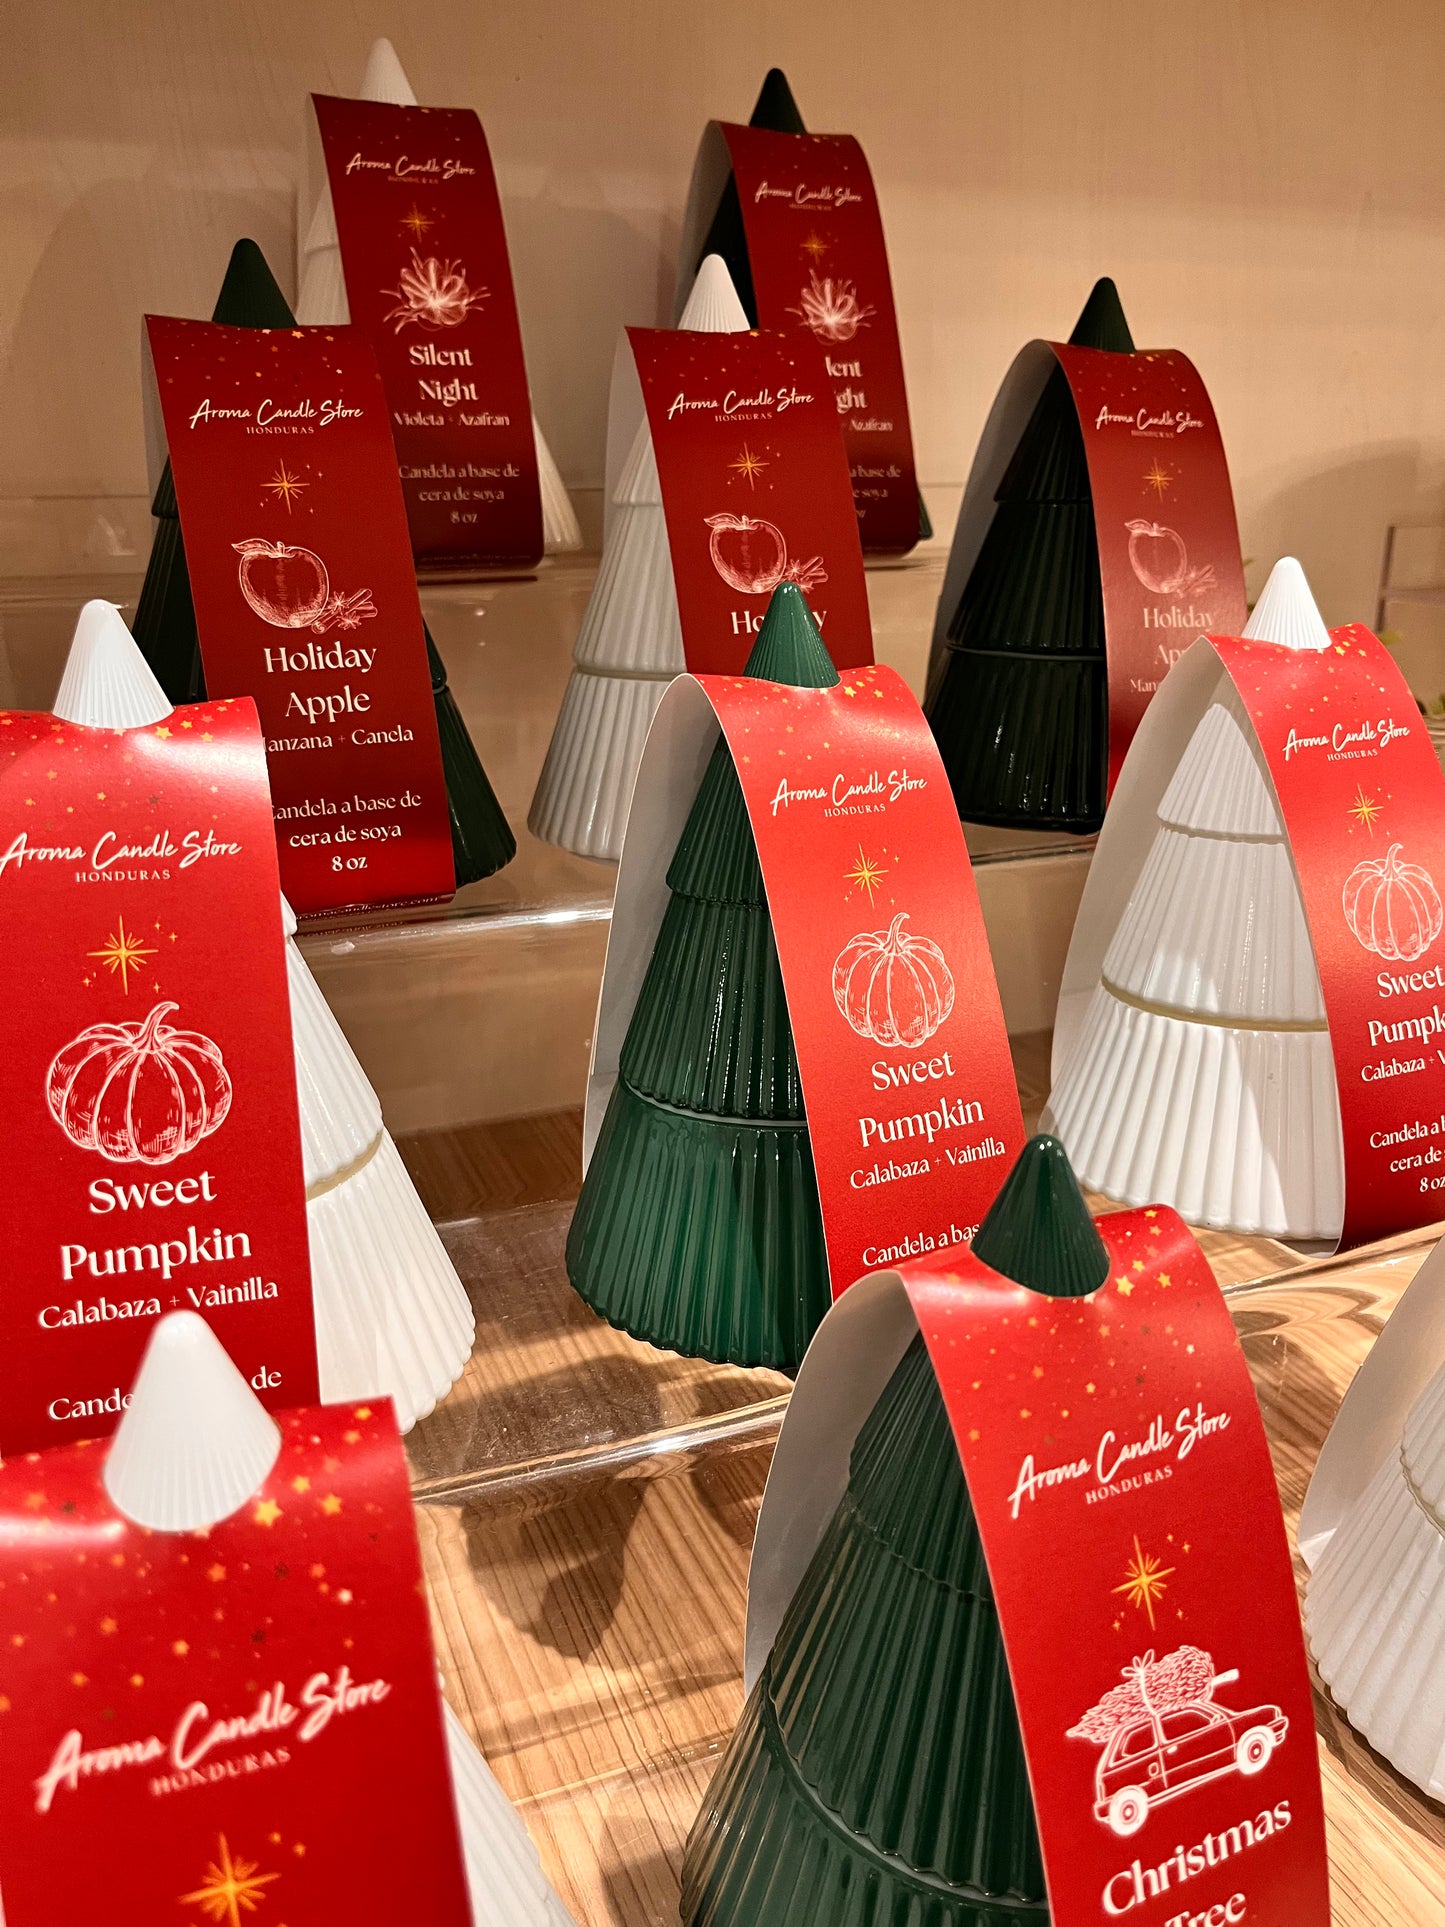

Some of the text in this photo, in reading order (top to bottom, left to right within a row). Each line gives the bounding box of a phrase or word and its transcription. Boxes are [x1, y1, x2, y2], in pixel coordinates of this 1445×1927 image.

[409, 343, 474, 368] Silent
[824, 355, 863, 378] lent
[418, 378, 479, 408] Night
[666, 386, 815, 421] Aroma Candle Store
[834, 387, 868, 414] ght
[188, 398, 364, 430] Aroma Candle Store
[714, 412, 773, 423] HONDURAS
[246, 426, 315, 435] HONDURAS
[1142, 605, 1215, 632] Holiday
[264, 640, 378, 674] Holiday
[285, 685, 372, 725] Apple
[263, 735, 333, 753] anzana
[351, 724, 414, 746] Canela
[1282, 718, 1412, 762] Aroma Candle Store
[1326, 747, 1379, 762] HONDURAS
[340, 802, 352, 814] a
[354, 794, 397, 813] base
[400, 790, 422, 808] de
[771, 770, 928, 817] Aroma Candle Store
[824, 803, 887, 818] HONDURAS
[0, 829, 243, 875] Aroma Candle Store
[289, 825, 402, 848] cera de soya
[76, 869, 172, 884] HONDURAS
[331, 856, 368, 872] 8 oz
[1376, 964, 1445, 999] Sweet
[1367, 1004, 1445, 1047] Pumpk
[871, 1051, 956, 1091] Sweet
[1360, 1057, 1426, 1082] Calabaza
[858, 1098, 986, 1148] Pumpkin
[1370, 1120, 1429, 1150] Candela
[1430, 1120, 1440, 1136] a
[849, 1158, 931, 1190] Calabaza
[945, 1136, 1006, 1167] Vainilla
[1389, 1146, 1442, 1174] cera de
[88, 1170, 218, 1214] Sweet
[1419, 1176, 1429, 1194] 8
[60, 1225, 252, 1282] Pumpkin
[862, 1223, 980, 1267] Candela a bas
[38, 1296, 162, 1330] Calabaza
[186, 1276, 279, 1309] Vainilla
[250, 1366, 283, 1391] de
[1008, 1402, 1232, 1520] Aroma Candle Store
[1085, 1464, 1174, 1505] HONDURAS
[33, 1663, 393, 1815] Aroma Candle Store
[1101, 1799, 1293, 1916] Christmas
